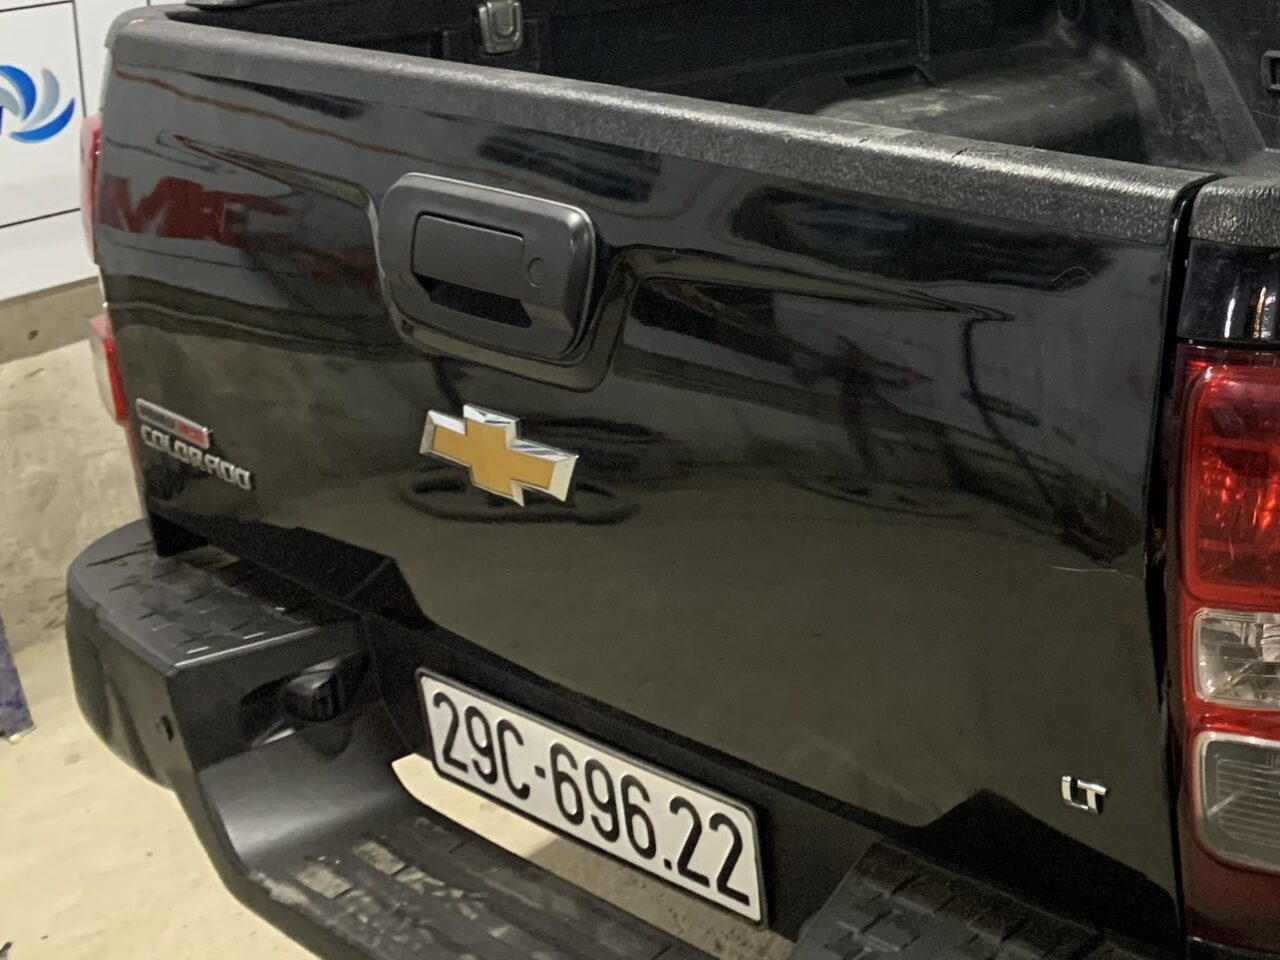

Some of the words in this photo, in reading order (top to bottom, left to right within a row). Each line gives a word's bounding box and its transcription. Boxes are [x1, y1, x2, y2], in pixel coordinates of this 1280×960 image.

[140, 424, 252, 491] COLORADO
[432, 690, 751, 907] 29C-696.22
[1061, 775, 1107, 814] LT
